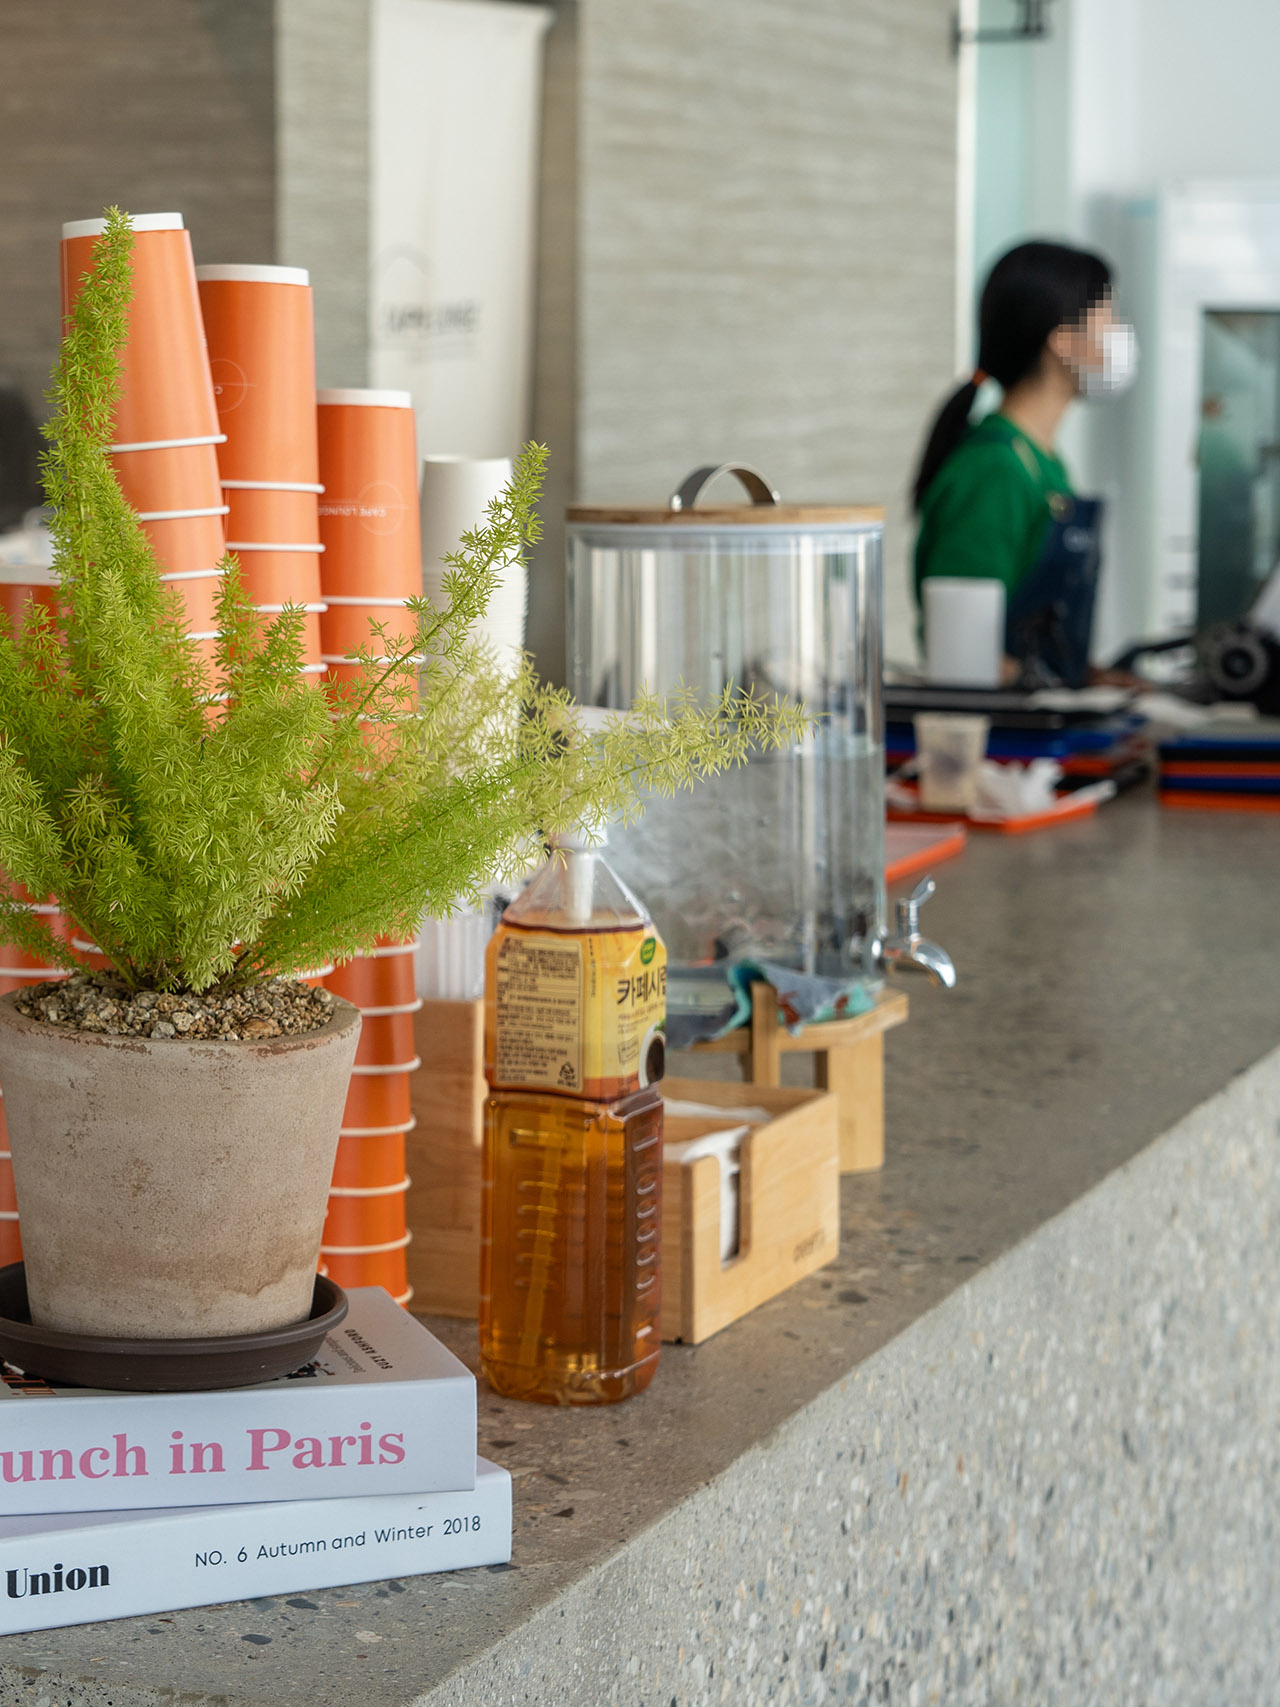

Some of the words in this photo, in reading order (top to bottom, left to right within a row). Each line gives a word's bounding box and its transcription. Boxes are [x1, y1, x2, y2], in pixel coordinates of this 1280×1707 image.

[344, 1329, 377, 1354] ASHFORD
[369, 1354, 393, 1370] SUZY
[168, 1430, 226, 1474] in
[245, 1421, 406, 1471] Paris
[195, 1550, 228, 1567] NO.
[237, 1546, 248, 1563] 6
[256, 1539, 327, 1560] Autumn
[331, 1531, 366, 1550] and
[374, 1523, 434, 1543] Winter
[443, 1515, 481, 1536] 2018
[5, 1563, 110, 1598] Union
